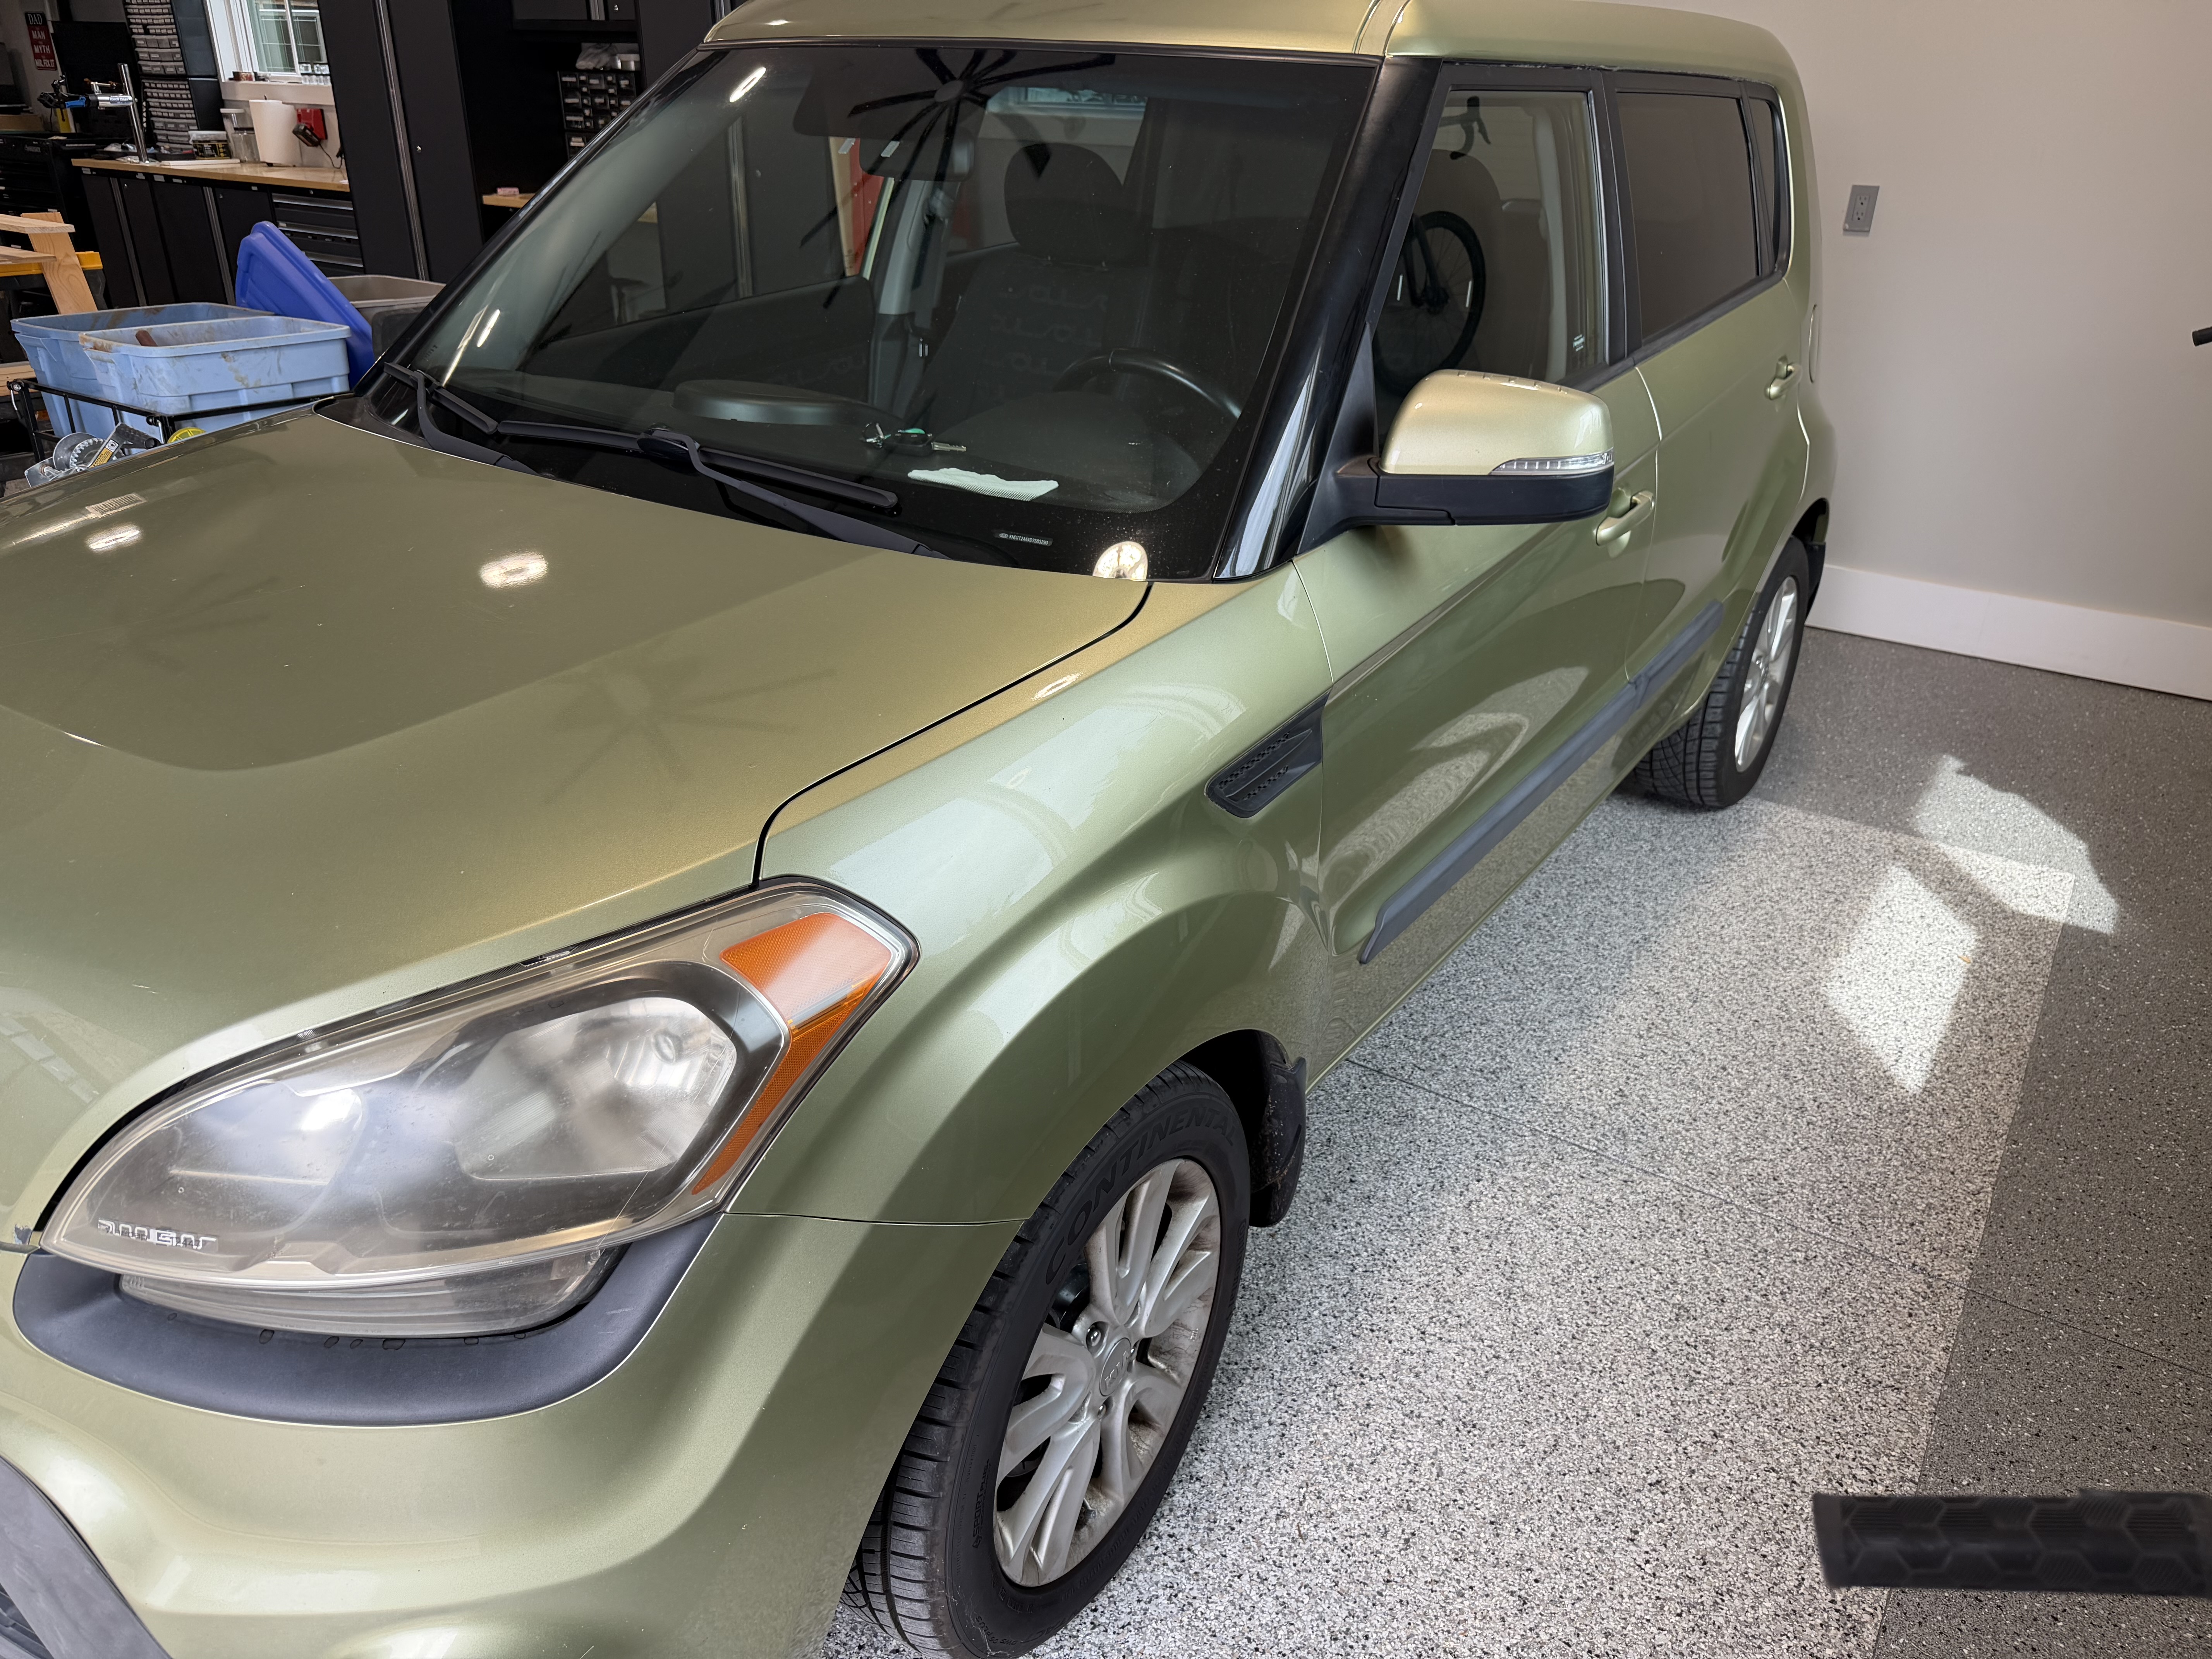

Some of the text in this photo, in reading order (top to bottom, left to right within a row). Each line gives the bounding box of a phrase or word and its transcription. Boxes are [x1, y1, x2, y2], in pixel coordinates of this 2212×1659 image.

[27, 14, 42, 25] DAD
[32, 31, 45, 40] MAN
[34, 45, 50, 53] MYTH
[1046, 1106, 1236, 1285] CONTINENTAL
[1104, 1350, 1129, 1390] KIA
[976, 1616, 993, 1637] PLUS
